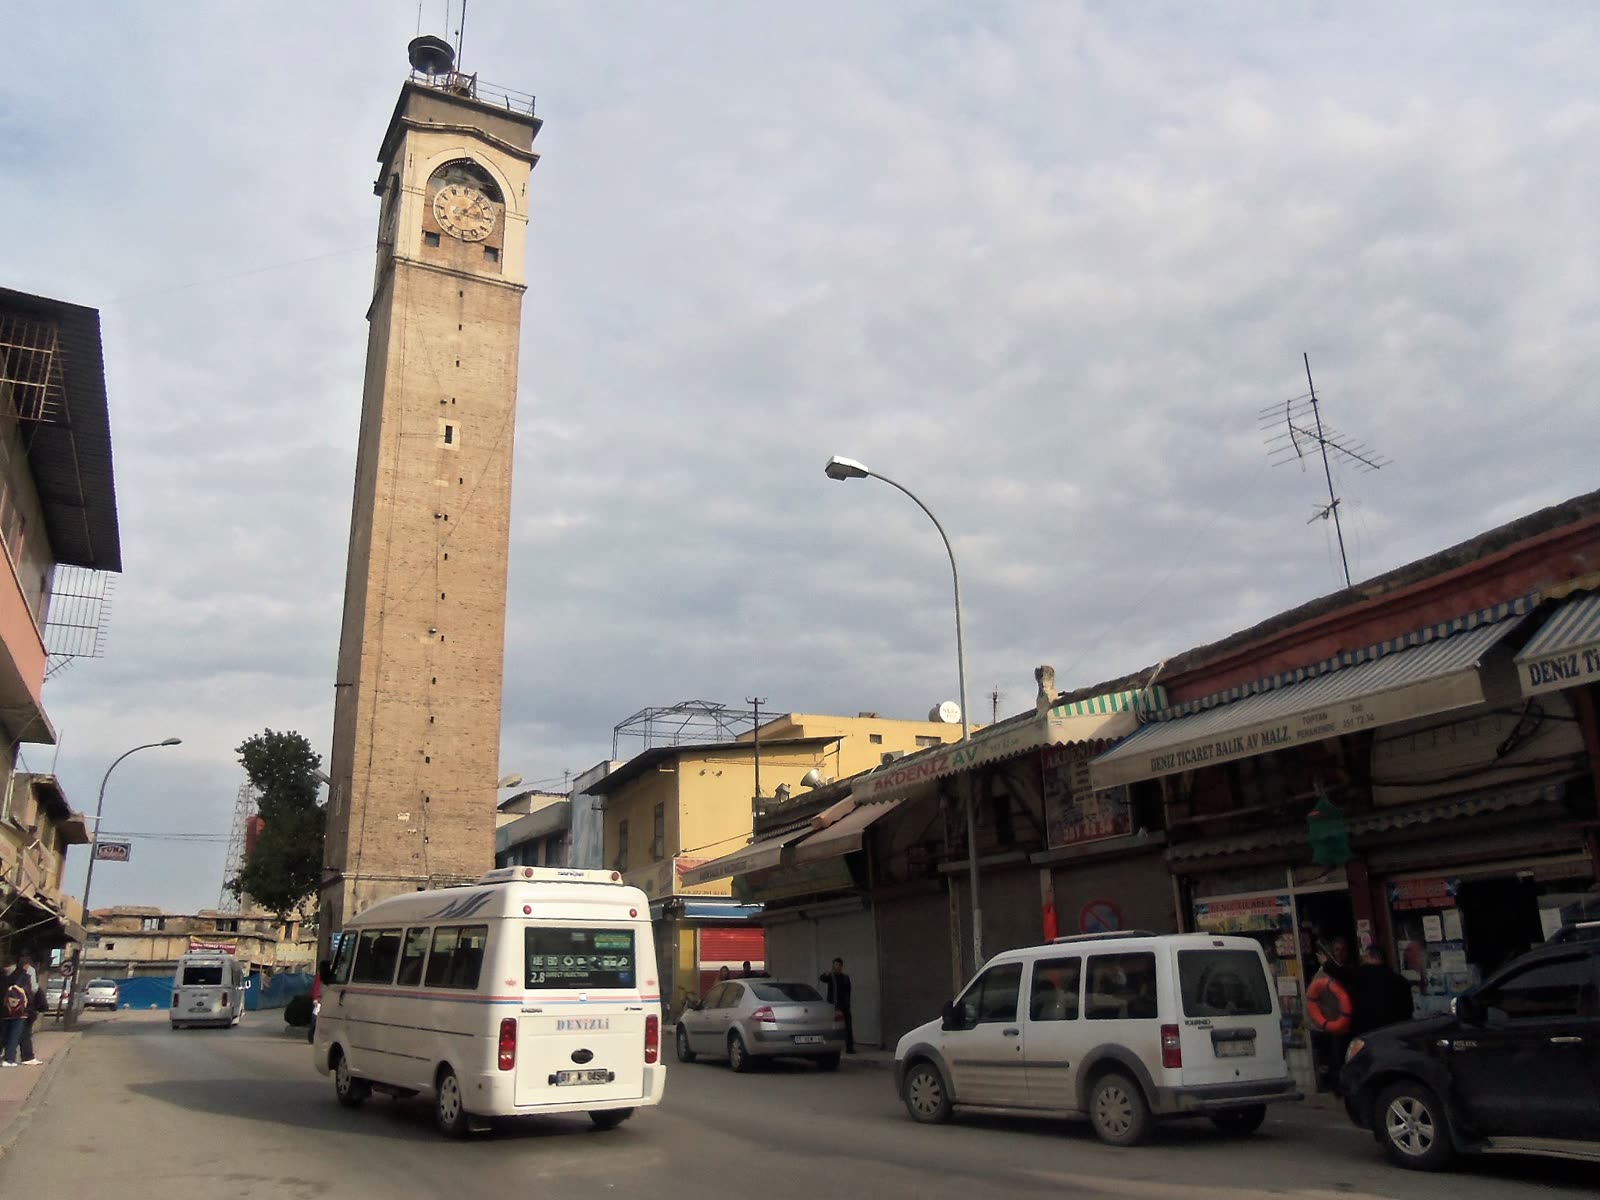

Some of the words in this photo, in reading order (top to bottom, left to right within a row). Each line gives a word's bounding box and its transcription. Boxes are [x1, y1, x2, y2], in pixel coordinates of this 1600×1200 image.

[1215, 736, 1245, 756] BALIK
[1247, 732, 1259, 750] AV
[951, 747, 978, 767] AV
[530, 971, 546, 984] 2.8
